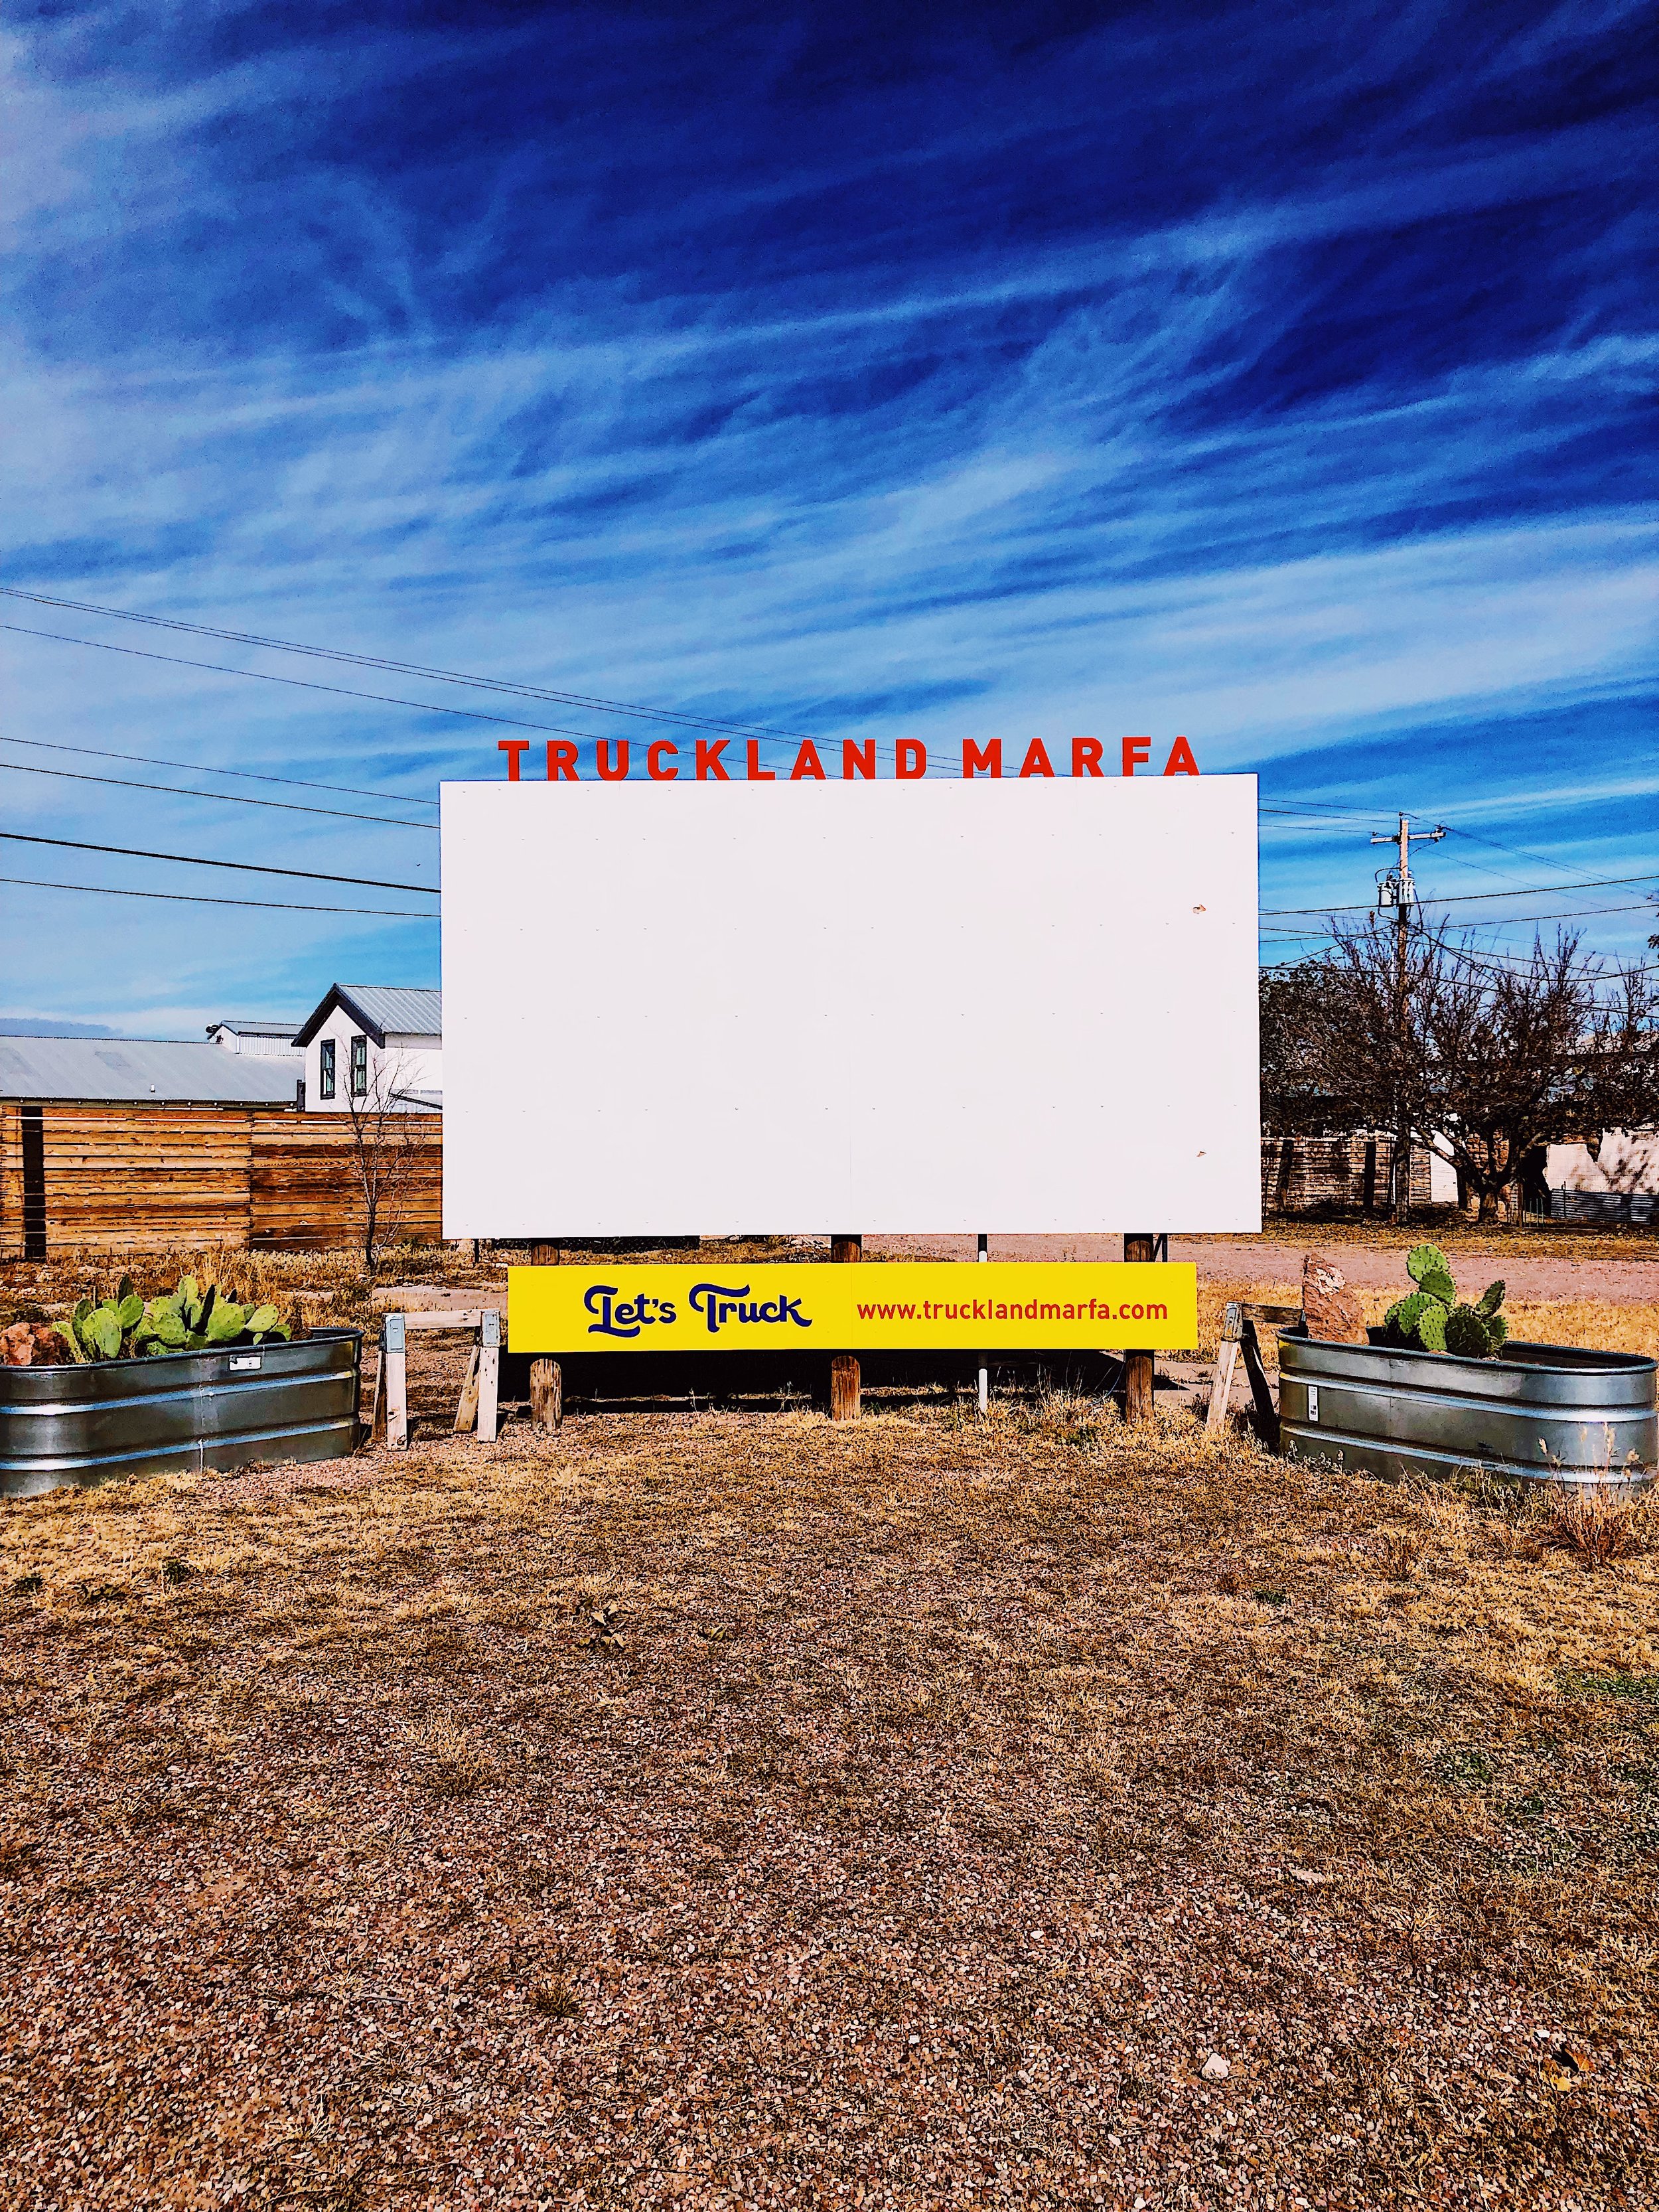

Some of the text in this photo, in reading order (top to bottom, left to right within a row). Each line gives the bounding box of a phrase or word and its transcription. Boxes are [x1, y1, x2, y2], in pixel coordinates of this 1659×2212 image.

[498, 736, 1200, 782] TRUCKLAND MARFA
[583, 1283, 812, 1338] Let's Truck
[857, 1298, 1168, 1320] www.trucklandmarfa.com
